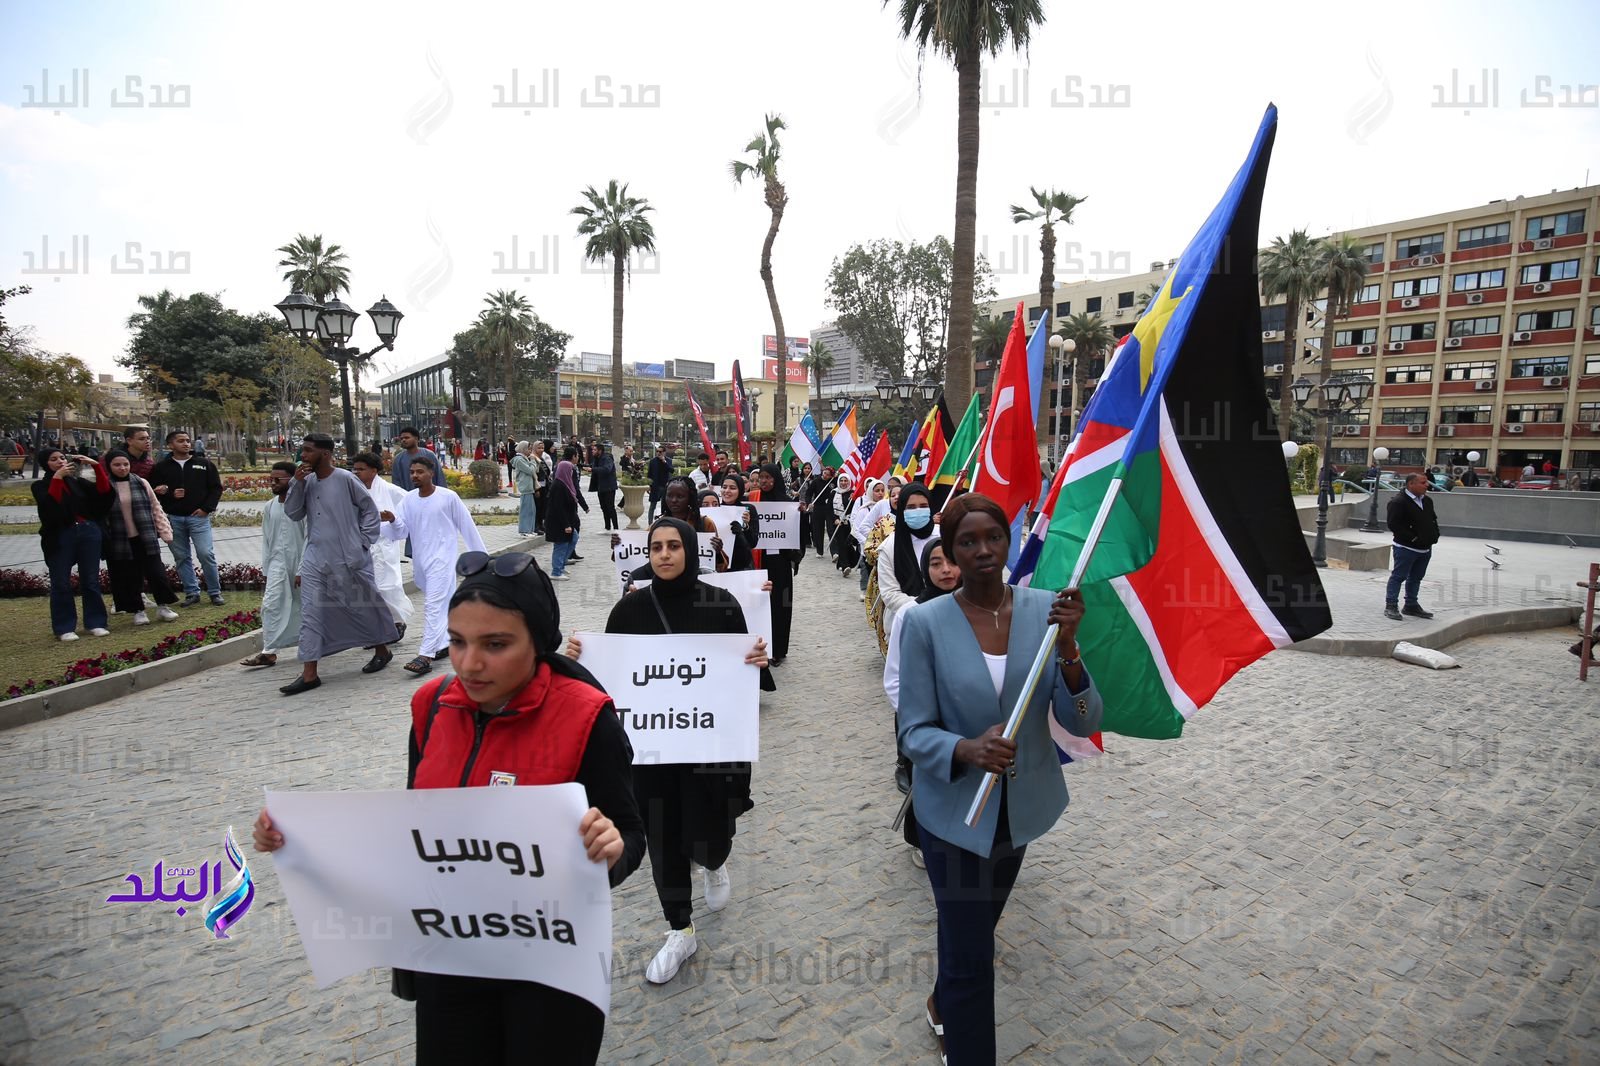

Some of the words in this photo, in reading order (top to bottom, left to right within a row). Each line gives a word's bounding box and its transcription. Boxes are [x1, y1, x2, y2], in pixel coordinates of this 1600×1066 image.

[785, 367, 802, 377] DiDi
[757, 511, 786, 523] الصوم
[757, 529, 786, 539] malia
[618, 543, 650, 560] ودان
[698, 546, 714, 562] جن
[632, 657, 706, 687] تونس
[615, 706, 715, 731] Tunisia
[411, 828, 545, 878] روسيا
[411, 908, 578, 947] Russia
